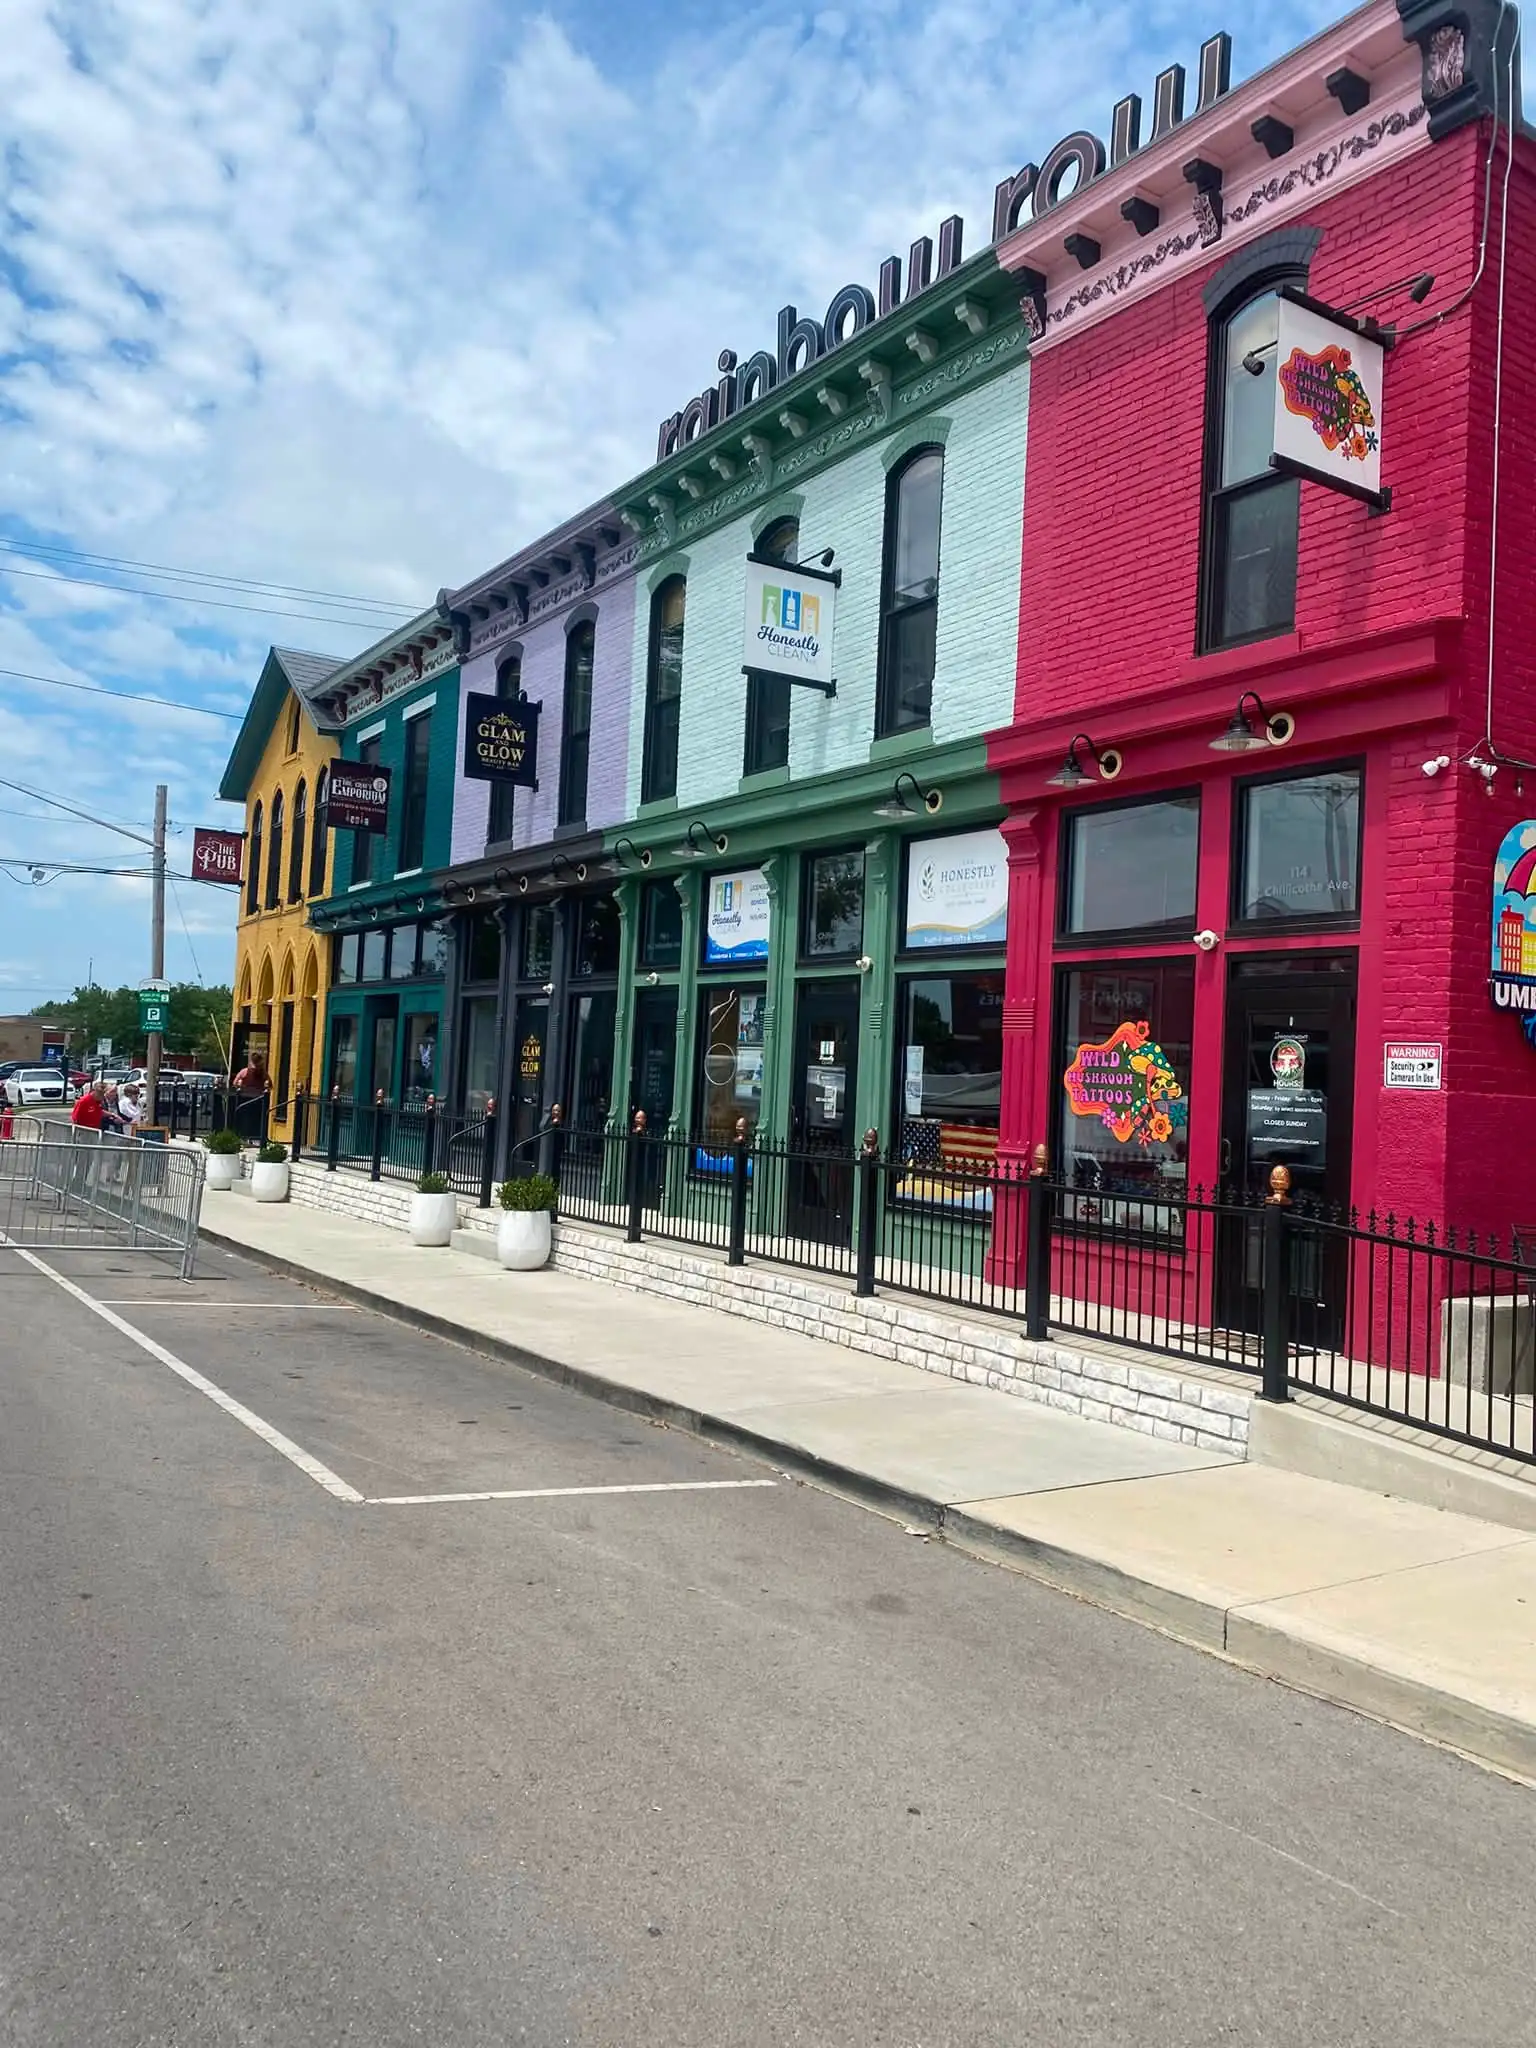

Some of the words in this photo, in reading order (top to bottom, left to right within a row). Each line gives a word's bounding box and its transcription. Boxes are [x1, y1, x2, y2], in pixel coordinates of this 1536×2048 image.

[657, 215, 962, 461] rainbow
[992, 31, 1232, 242] row
[1294, 354, 1329, 382] WILD
[1283, 368, 1339, 402] MUSHROOM
[1288, 388, 1338, 419] TATTOOS
[757, 625, 820, 656] Honestly
[768, 644, 810, 663] CLEAN
[478, 723, 526, 743] GLAM
[477, 742, 526, 762] GLOW
[331, 778, 386, 805] EMPORIUM
[213, 841, 236, 856] THE
[196, 845, 236, 871] PUB
[940, 865, 996, 883] HONESTLY
[1290, 866, 1309, 878] 114
[1327, 880, 1352, 891] Ave.
[712, 911, 742, 927] Honestly
[522, 1045, 541, 1057] GLAM
[1080, 1051, 1120, 1068] WILD
[1390, 1047, 1436, 1058] WARNING
[521, 1062, 541, 1073] GLOW
[1390, 1061, 1415, 1072] Security
[1068, 1071, 1133, 1085] MUSHROOM
[1390, 1072, 1415, 1082] Cameras
[1416, 1073, 1422, 1082] In
[1423, 1074, 1434, 1083] Use
[1072, 1089, 1133, 1104] TATTOOS
